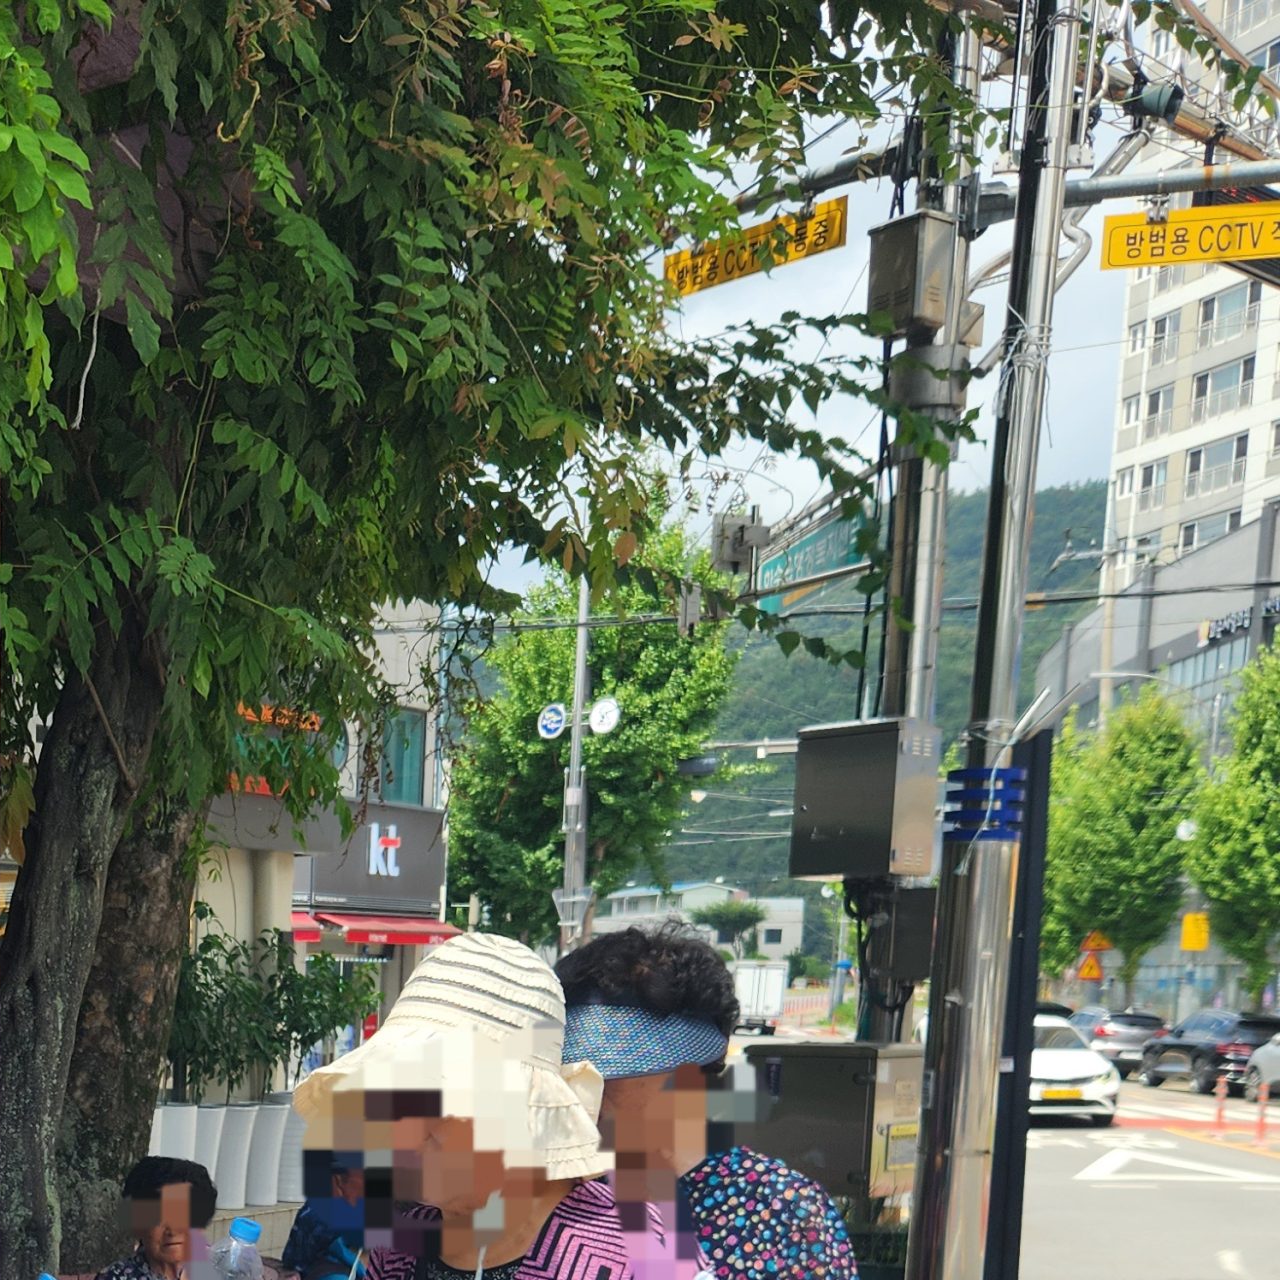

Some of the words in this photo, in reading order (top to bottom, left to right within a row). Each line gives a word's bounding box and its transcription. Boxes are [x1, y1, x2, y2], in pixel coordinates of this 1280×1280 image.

[675, 255, 720, 292] 방범용
[723, 240, 768, 275] CCT
[1126, 227, 1190, 258] 방범용
[1198, 222, 1264, 253] CCTV
[368, 822, 401, 877] kt
